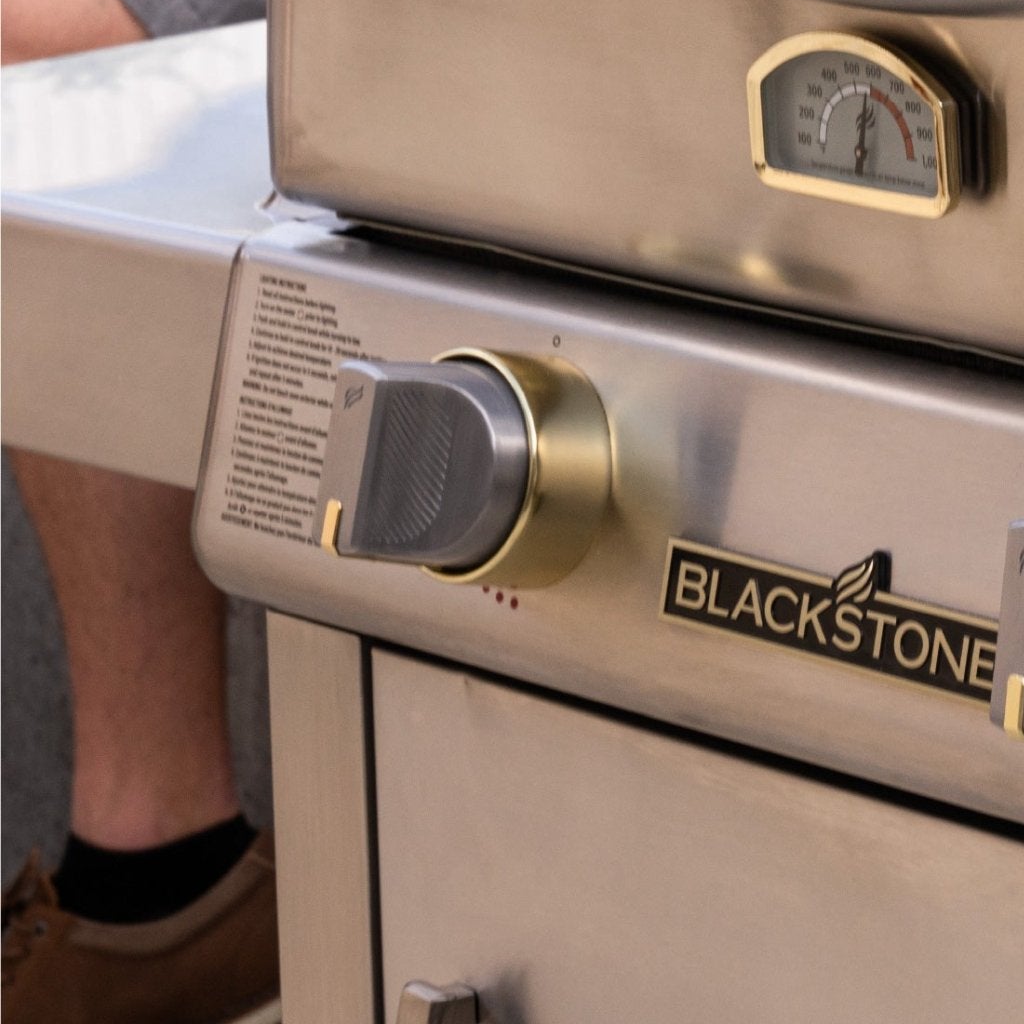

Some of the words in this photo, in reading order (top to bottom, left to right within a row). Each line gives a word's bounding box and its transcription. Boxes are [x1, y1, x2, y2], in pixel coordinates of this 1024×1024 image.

[821, 67, 837, 82] 400
[843, 61, 860, 75] 500
[865, 64, 881, 79] 600
[807, 83, 823, 98] 300
[889, 80, 905, 95] 700
[799, 106, 815, 120] 200
[905, 101, 922, 114] 800
[798, 131, 812, 146] 100
[916, 127, 933, 142] 900
[675, 560, 996, 689] BLACKSTONE
